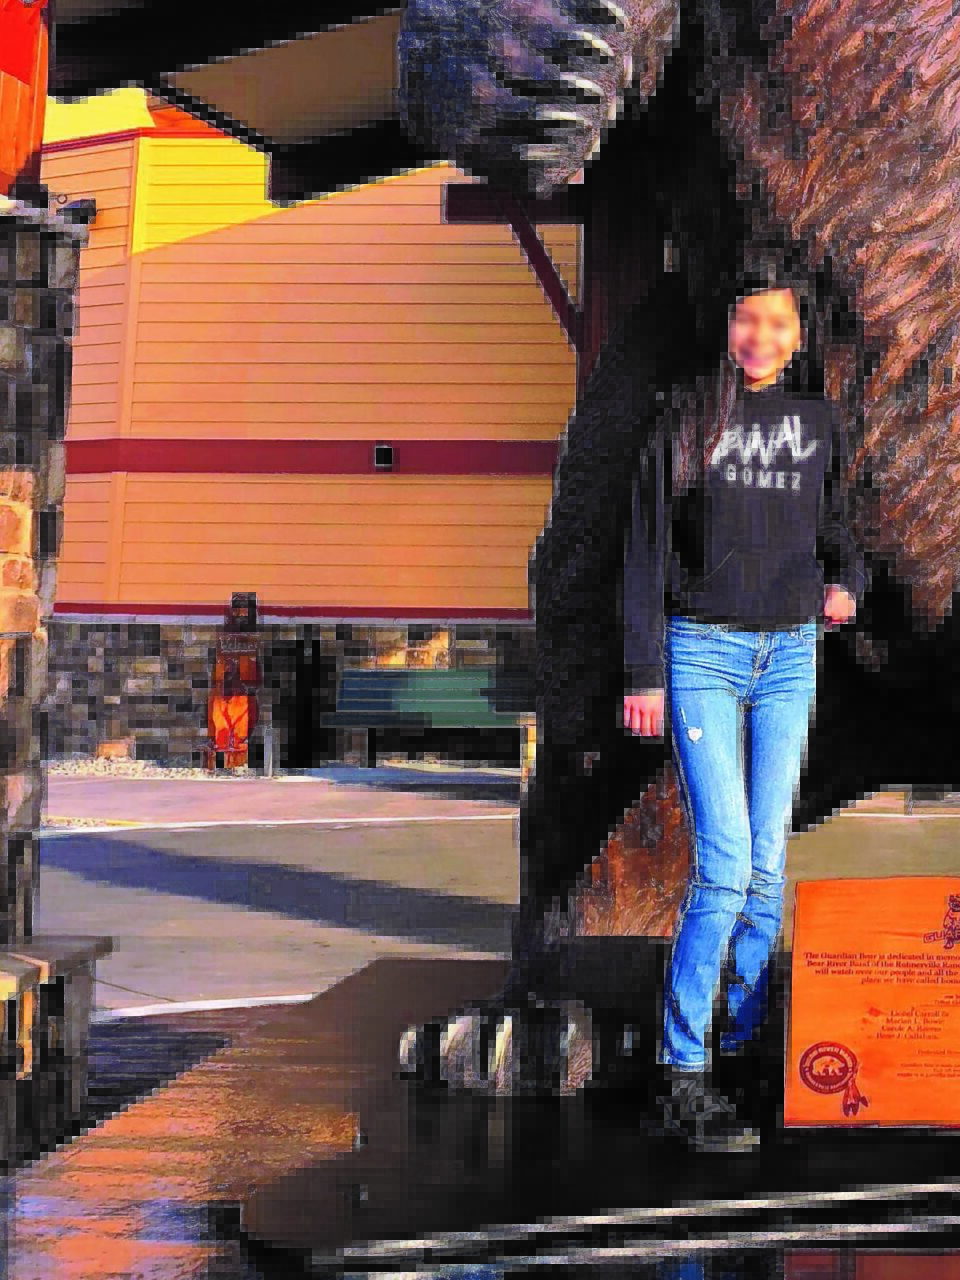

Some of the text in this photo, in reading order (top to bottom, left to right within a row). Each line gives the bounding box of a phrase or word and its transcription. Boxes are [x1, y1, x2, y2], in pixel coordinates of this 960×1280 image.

[726, 464, 801, 489] GOMEZ
[821, 952, 857, 960] Guardian
[890, 969, 915, 977] people
